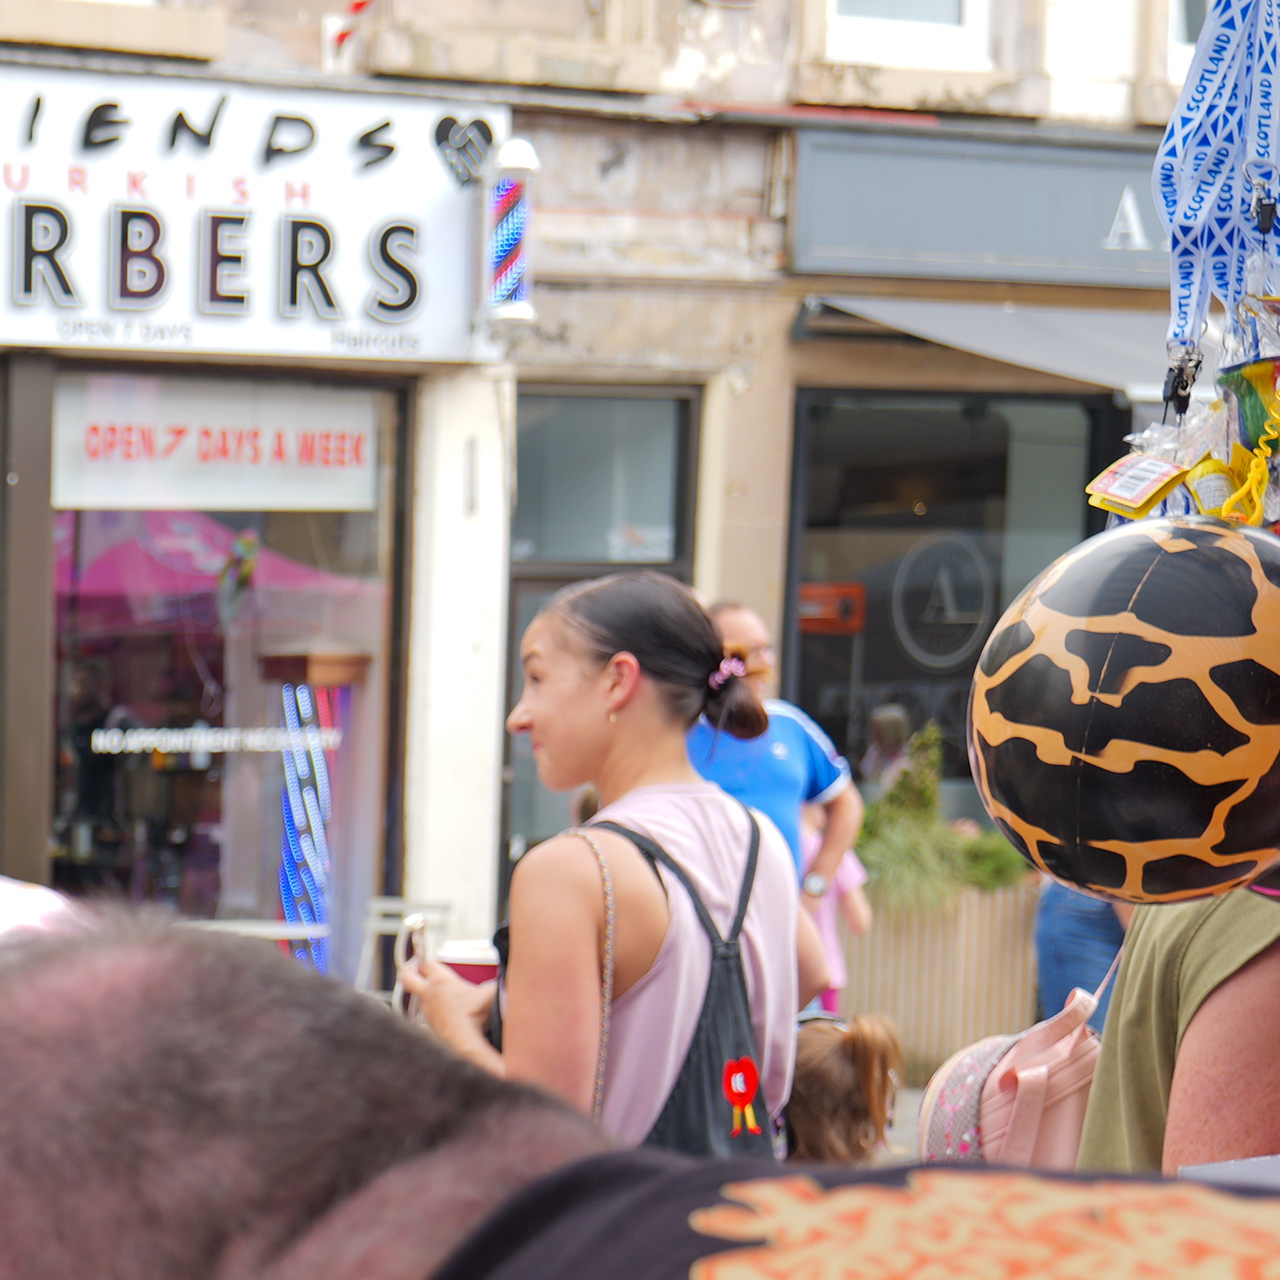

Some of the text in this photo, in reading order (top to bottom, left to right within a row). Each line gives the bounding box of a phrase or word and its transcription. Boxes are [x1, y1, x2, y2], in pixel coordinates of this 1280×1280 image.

[1186, 33, 1231, 114] SCOTLAND
[1256, 78, 1272, 158] SCOTLAND
[1184, 148, 1229, 221] SCOTLAND
[1174, 260, 1194, 346] SCOTLAND
[84, 423, 369, 468] OPEN 7 DAYS A WEEK
[92, 728, 124, 754] NO
